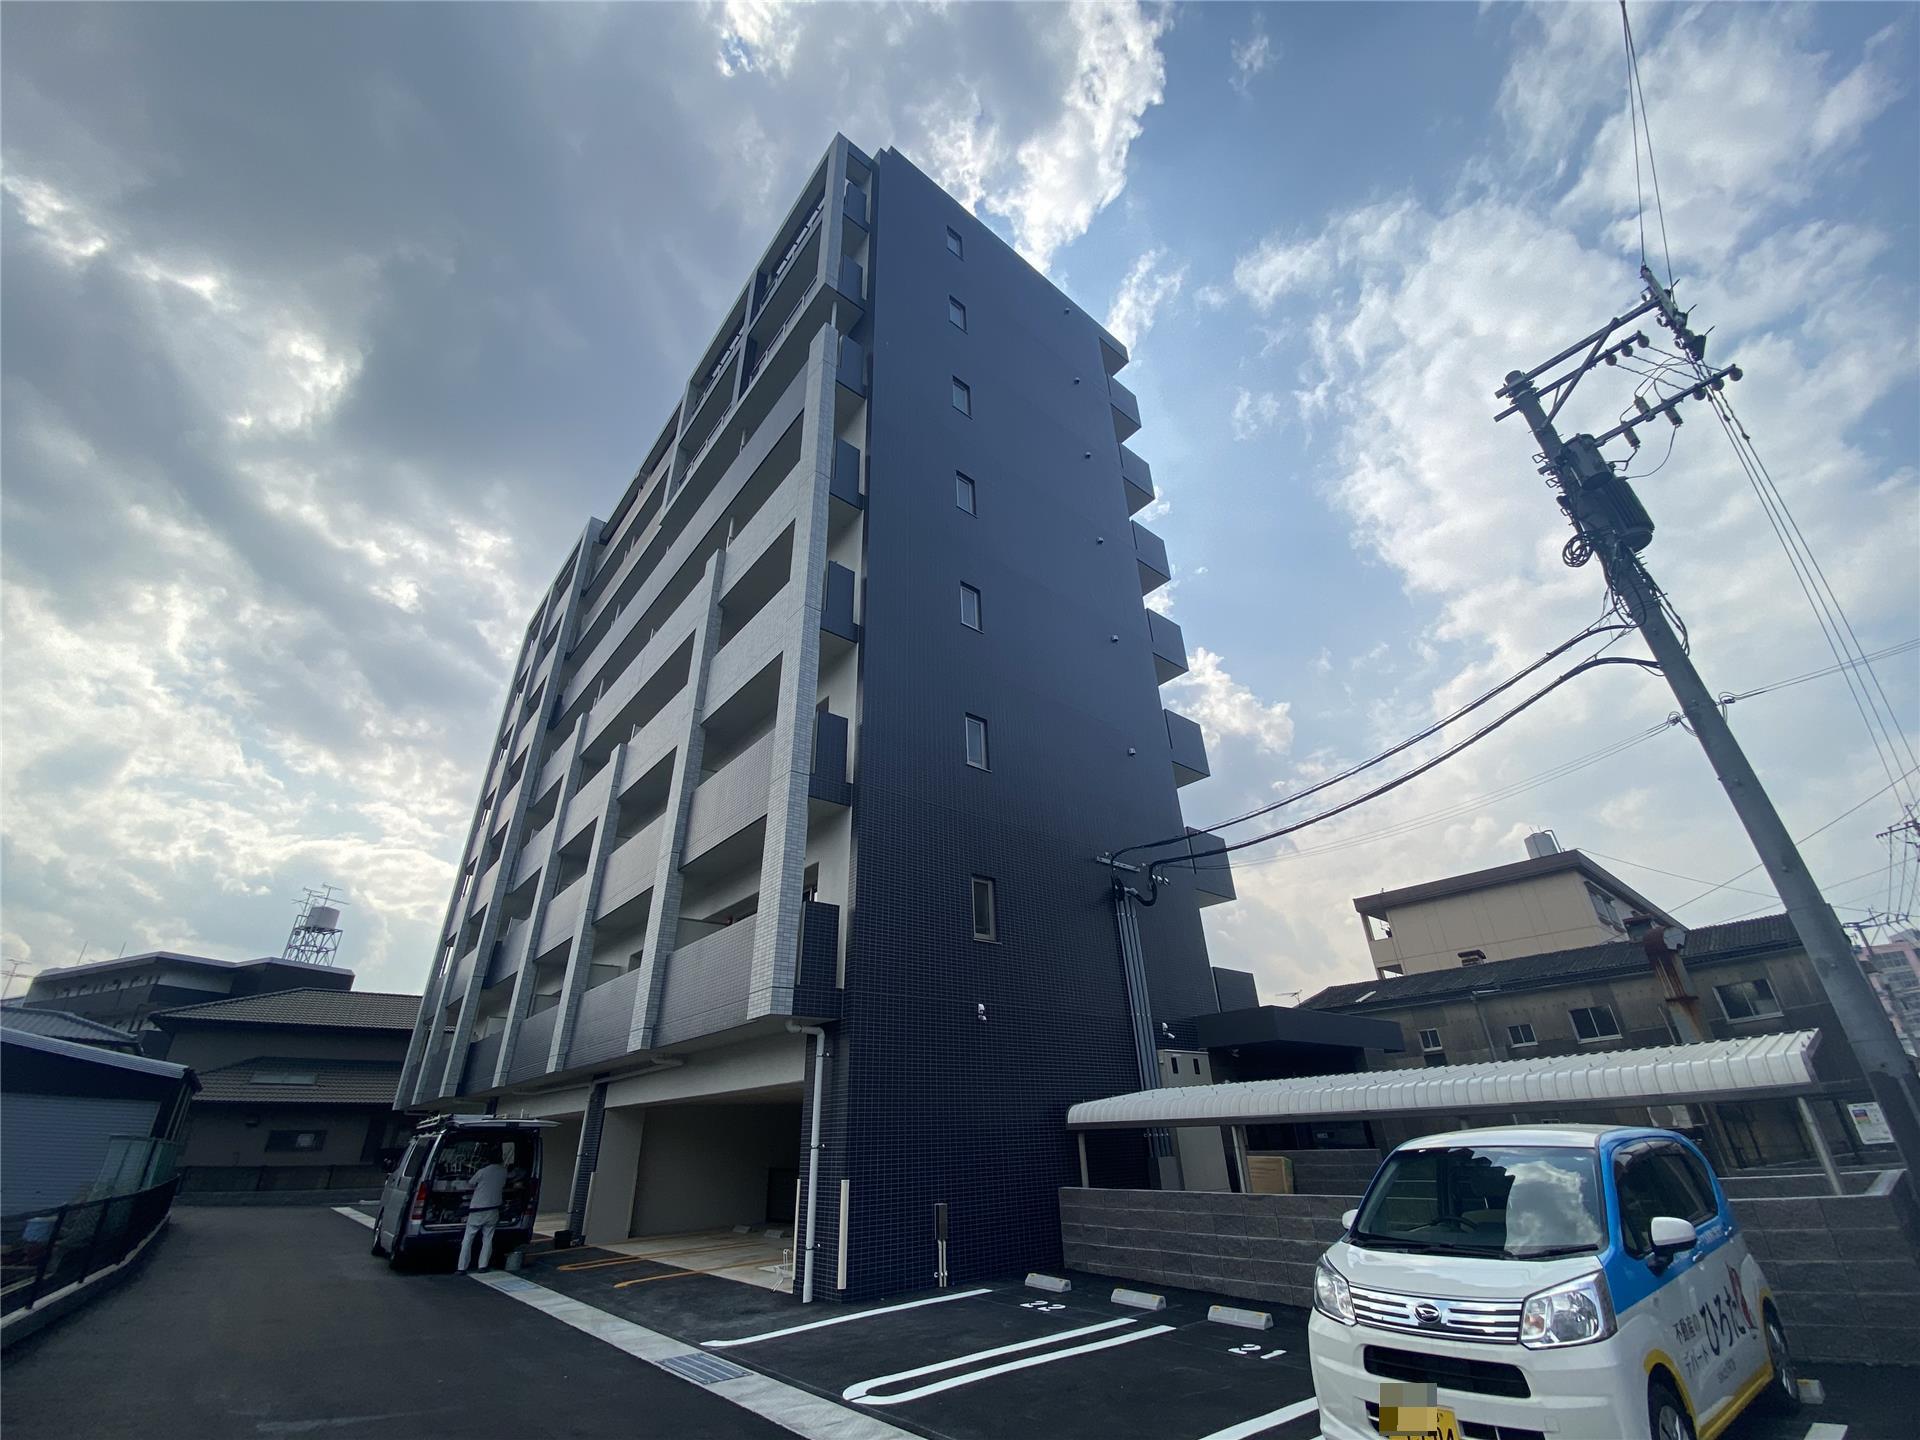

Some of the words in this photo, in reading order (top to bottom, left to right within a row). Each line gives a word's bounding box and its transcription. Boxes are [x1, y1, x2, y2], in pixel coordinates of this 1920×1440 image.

[1672, 1313, 1700, 1344] 不動産の
[1699, 1285, 1747, 1356] ひろた
